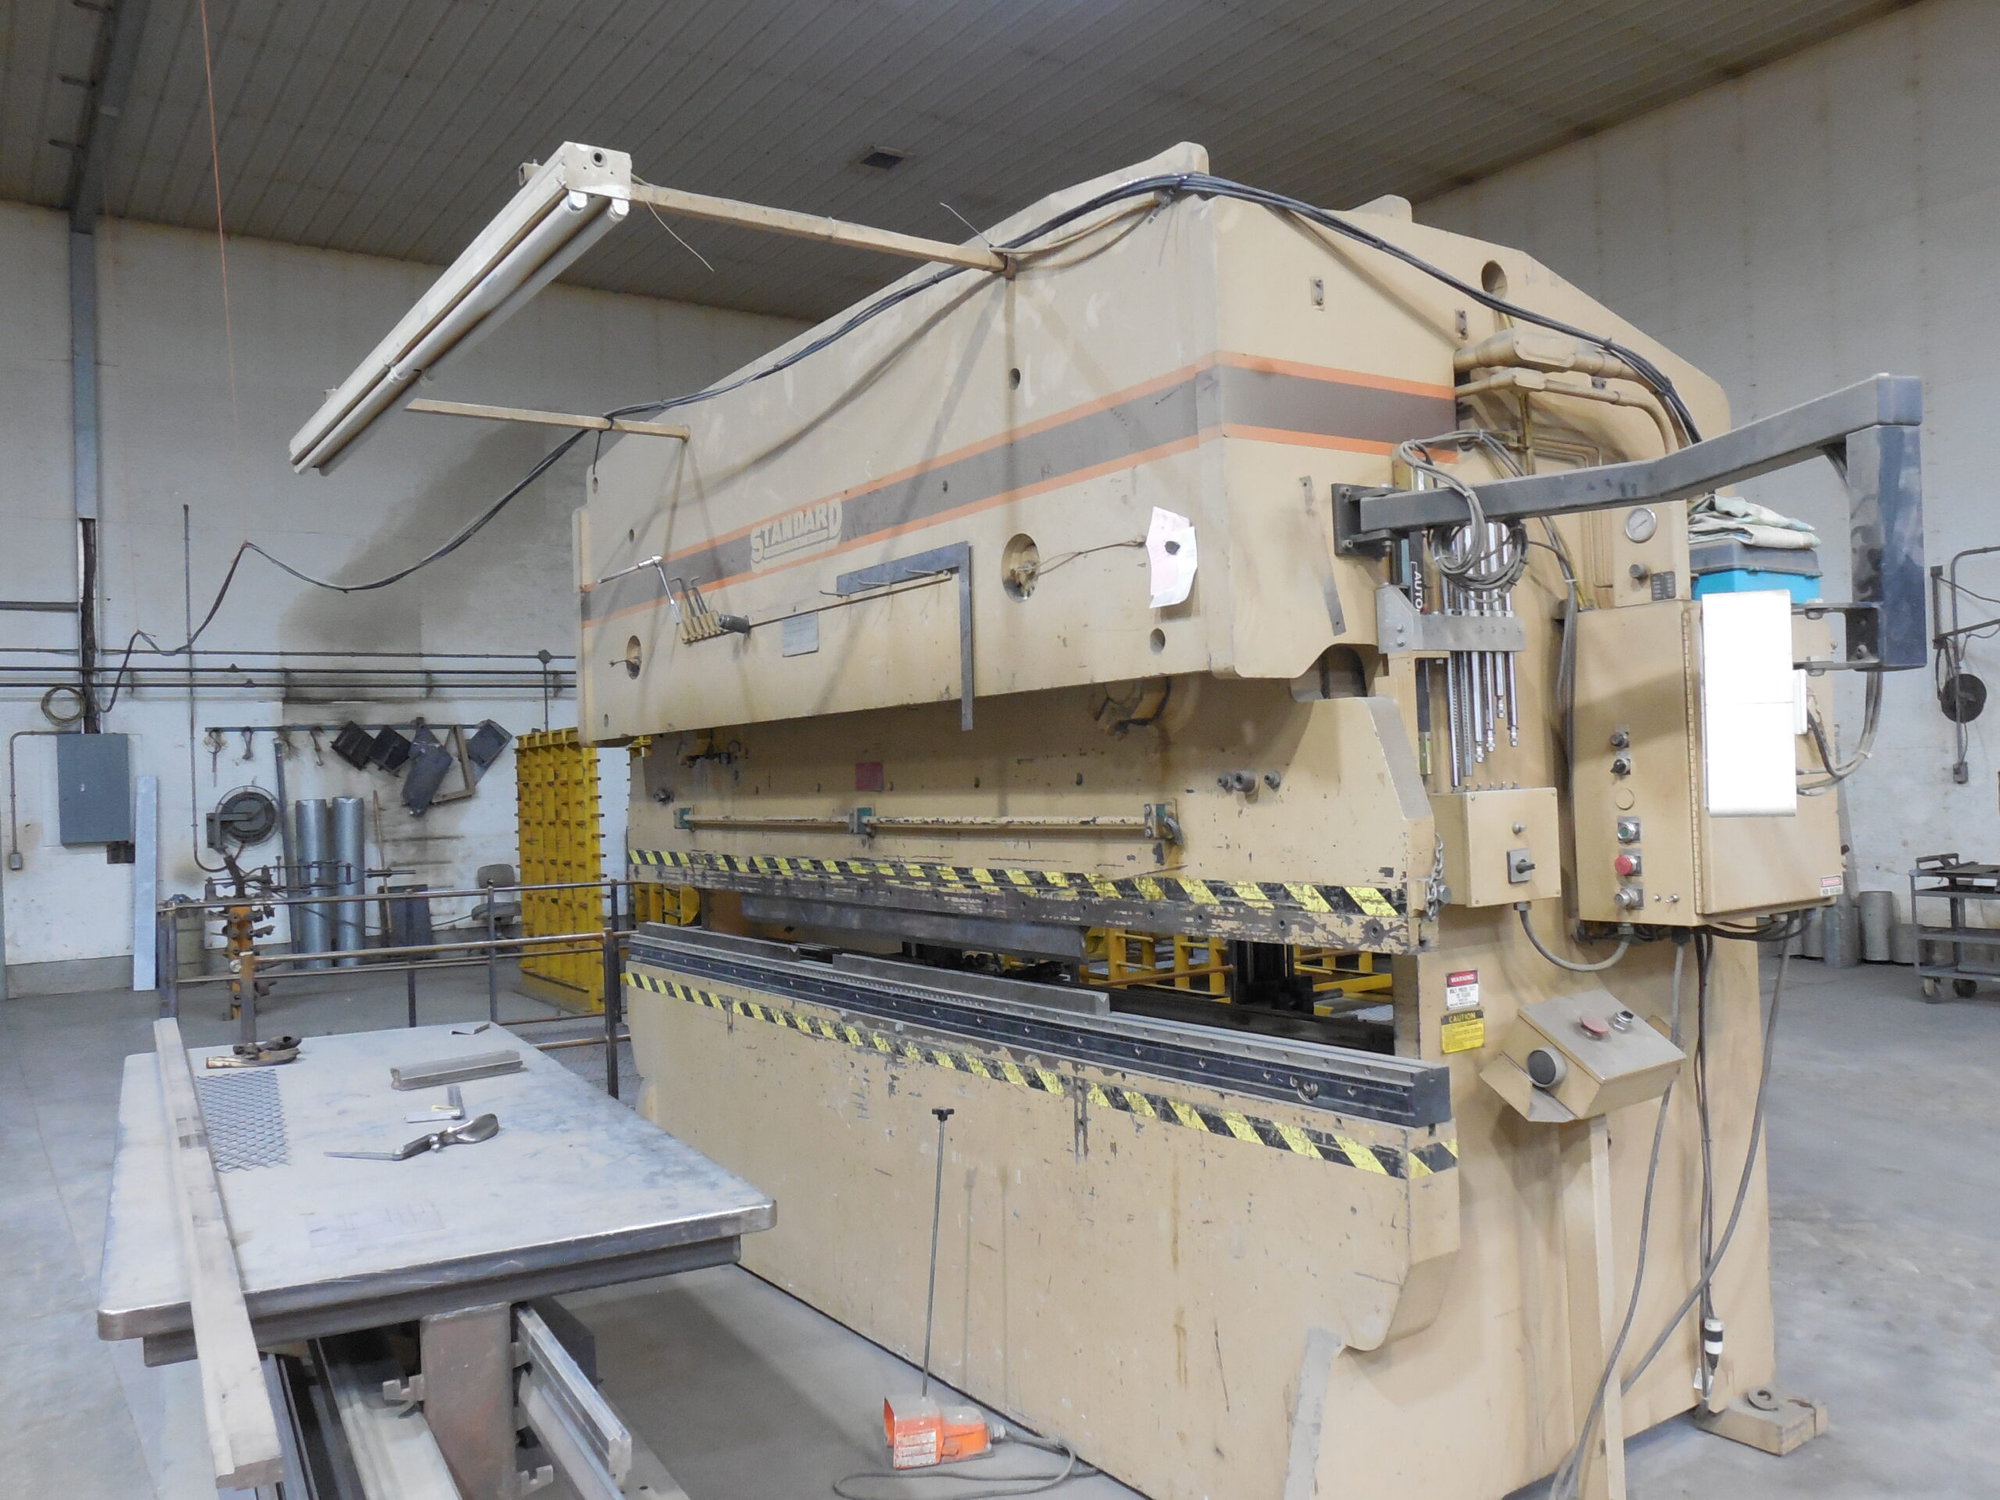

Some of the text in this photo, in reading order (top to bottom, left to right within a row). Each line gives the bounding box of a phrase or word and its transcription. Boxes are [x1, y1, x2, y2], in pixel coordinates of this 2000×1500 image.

[751, 499, 842, 564] STANDARD
[1414, 571, 1423, 612] AUTO
[1451, 974, 1475, 983] WARNING
[1449, 1012, 1476, 1023] CAUTION
